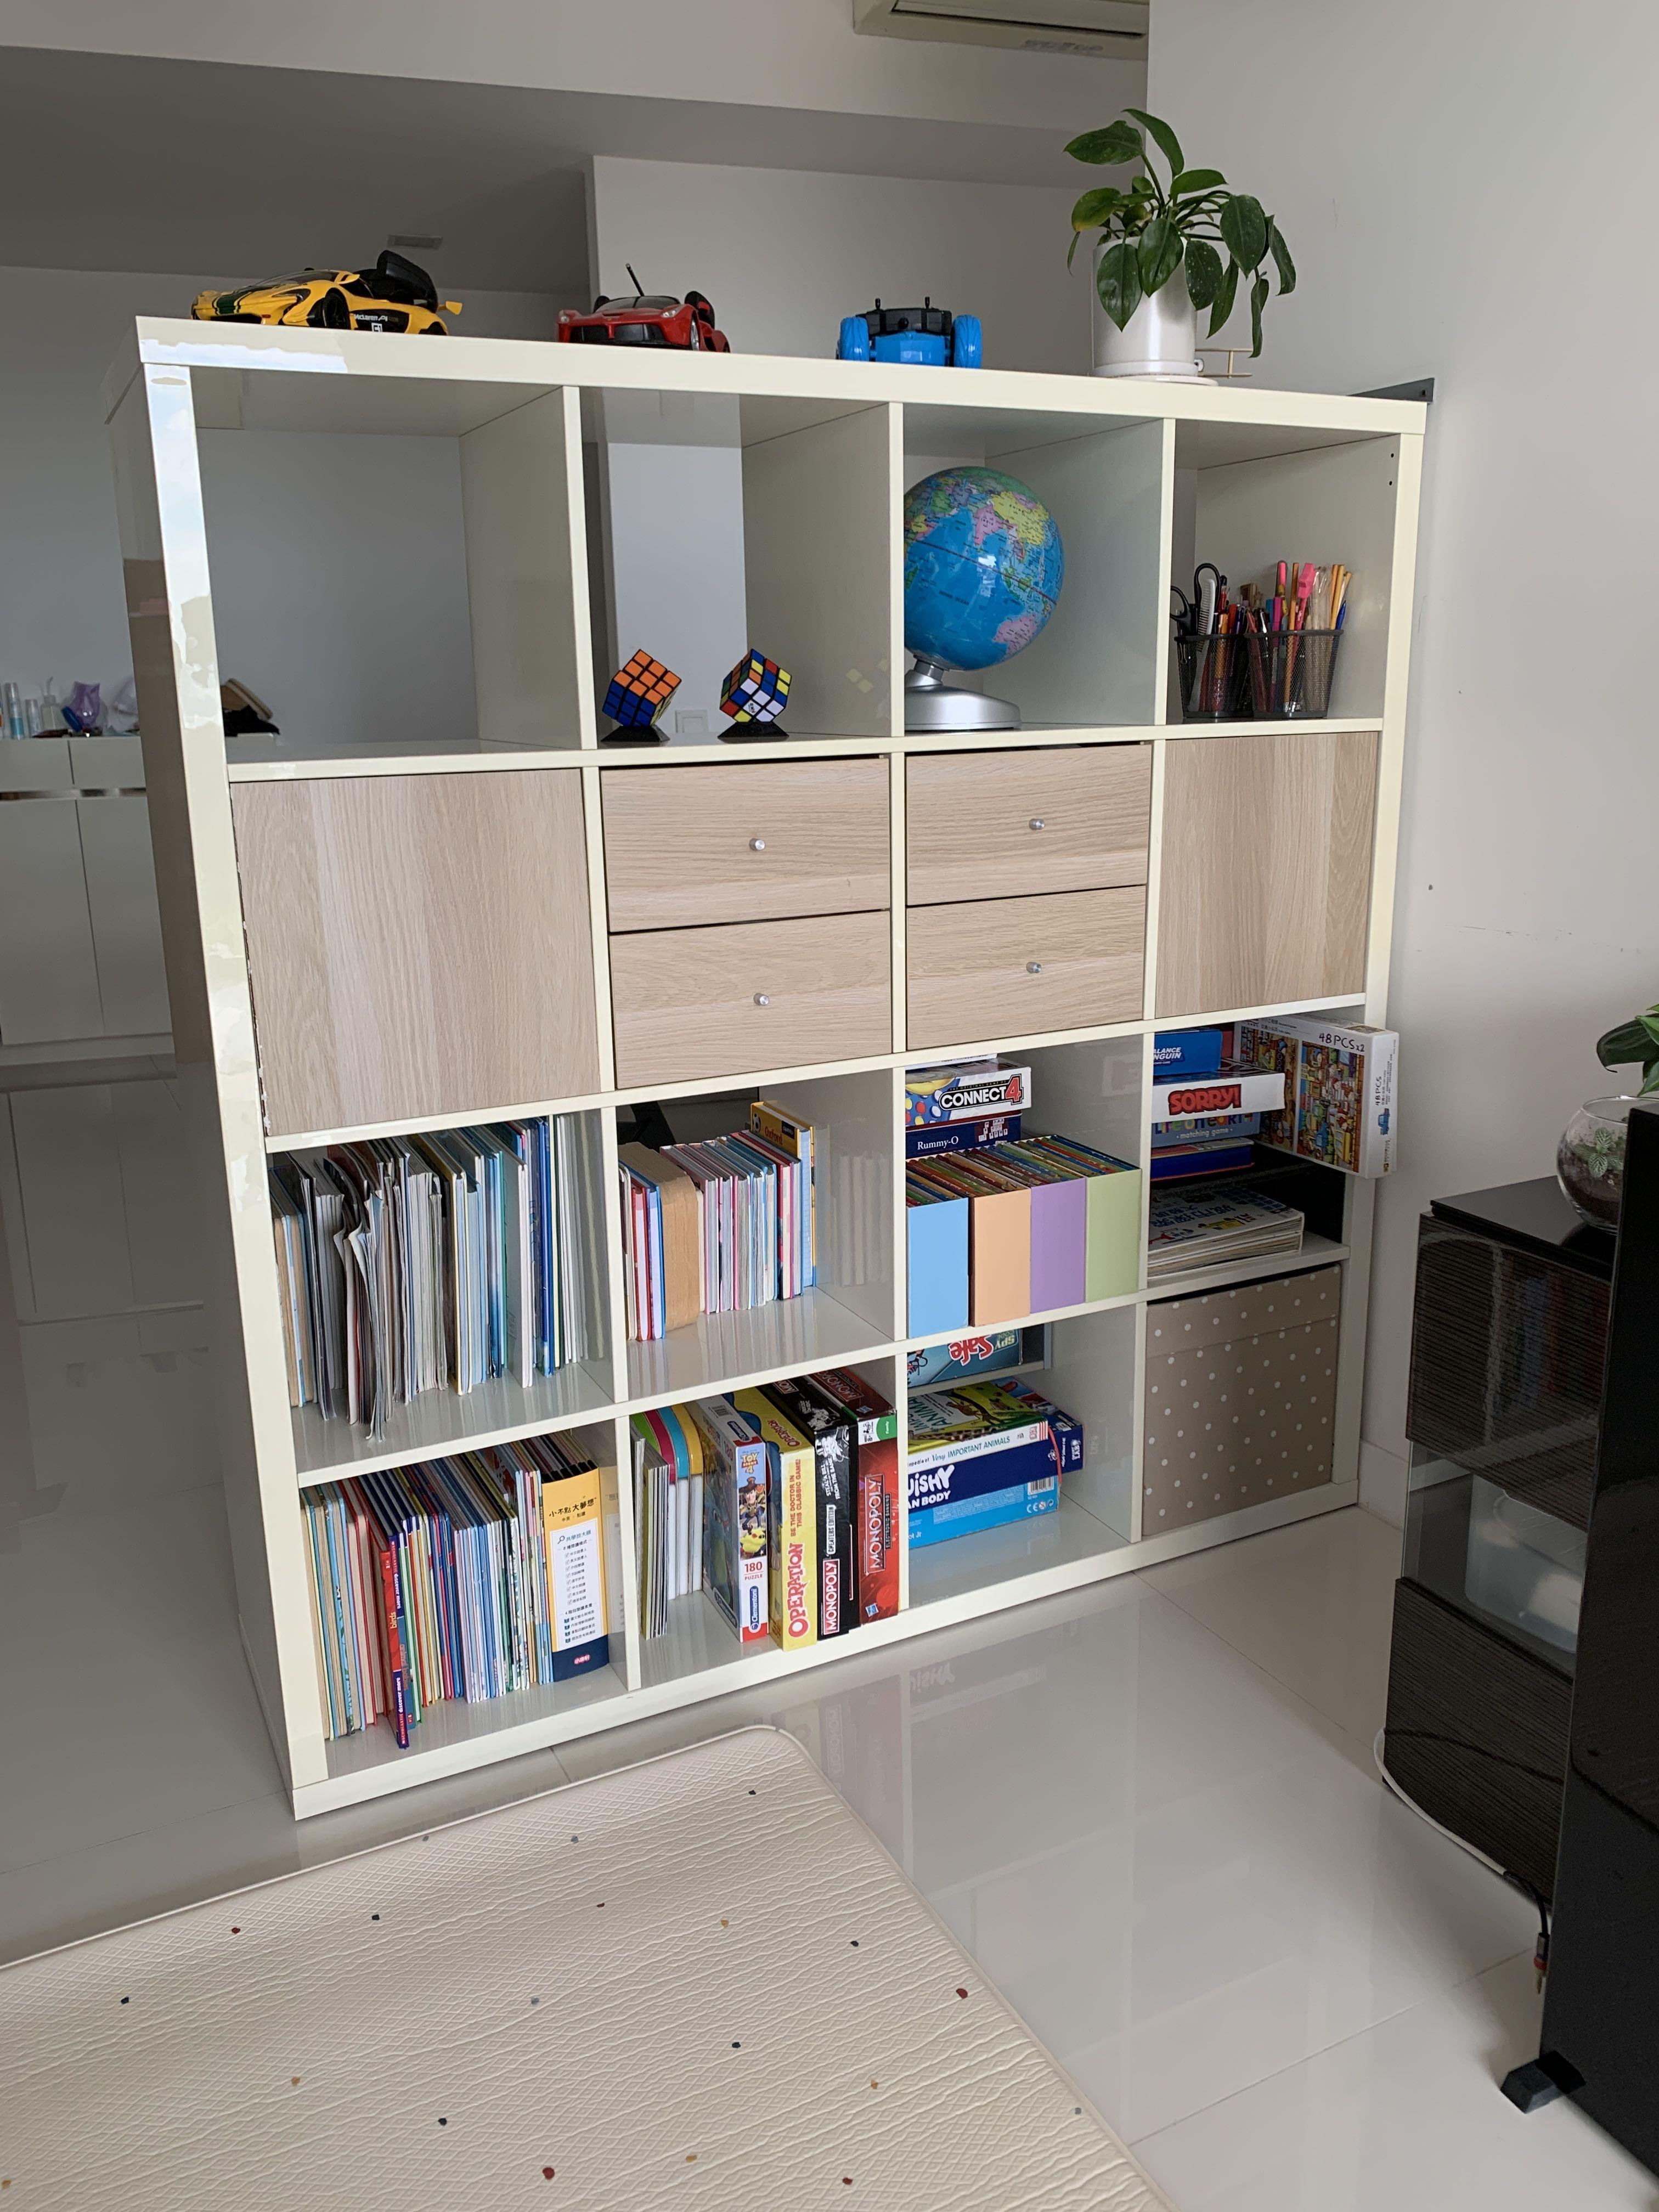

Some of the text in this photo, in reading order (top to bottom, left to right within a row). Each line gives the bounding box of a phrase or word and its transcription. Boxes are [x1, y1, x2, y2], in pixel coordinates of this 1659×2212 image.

[941, 1076, 1022, 1108] CONNECT 4
[1169, 1086, 1241, 1114] SORRY!
[765, 1126, 783, 1145] Oxford
[1180, 1128, 1229, 1139] matching game
[917, 1136, 959, 1150] Rummy-O
[947, 1443, 983, 1458] IMPORTANT
[983, 1436, 1011, 1448] ANIMALS
[741, 1452, 760, 1463] TOY
[789, 1475, 794, 1483] IN
[921, 1490, 951, 1506] BODY
[868, 1479, 882, 1568] MONOPOLY
[744, 1561, 763, 1573] 180
[787, 1542, 809, 1638] OPERATION
[826, 1562, 837, 1631] MONOPOLY
[390, 1612, 398, 1629] birds
